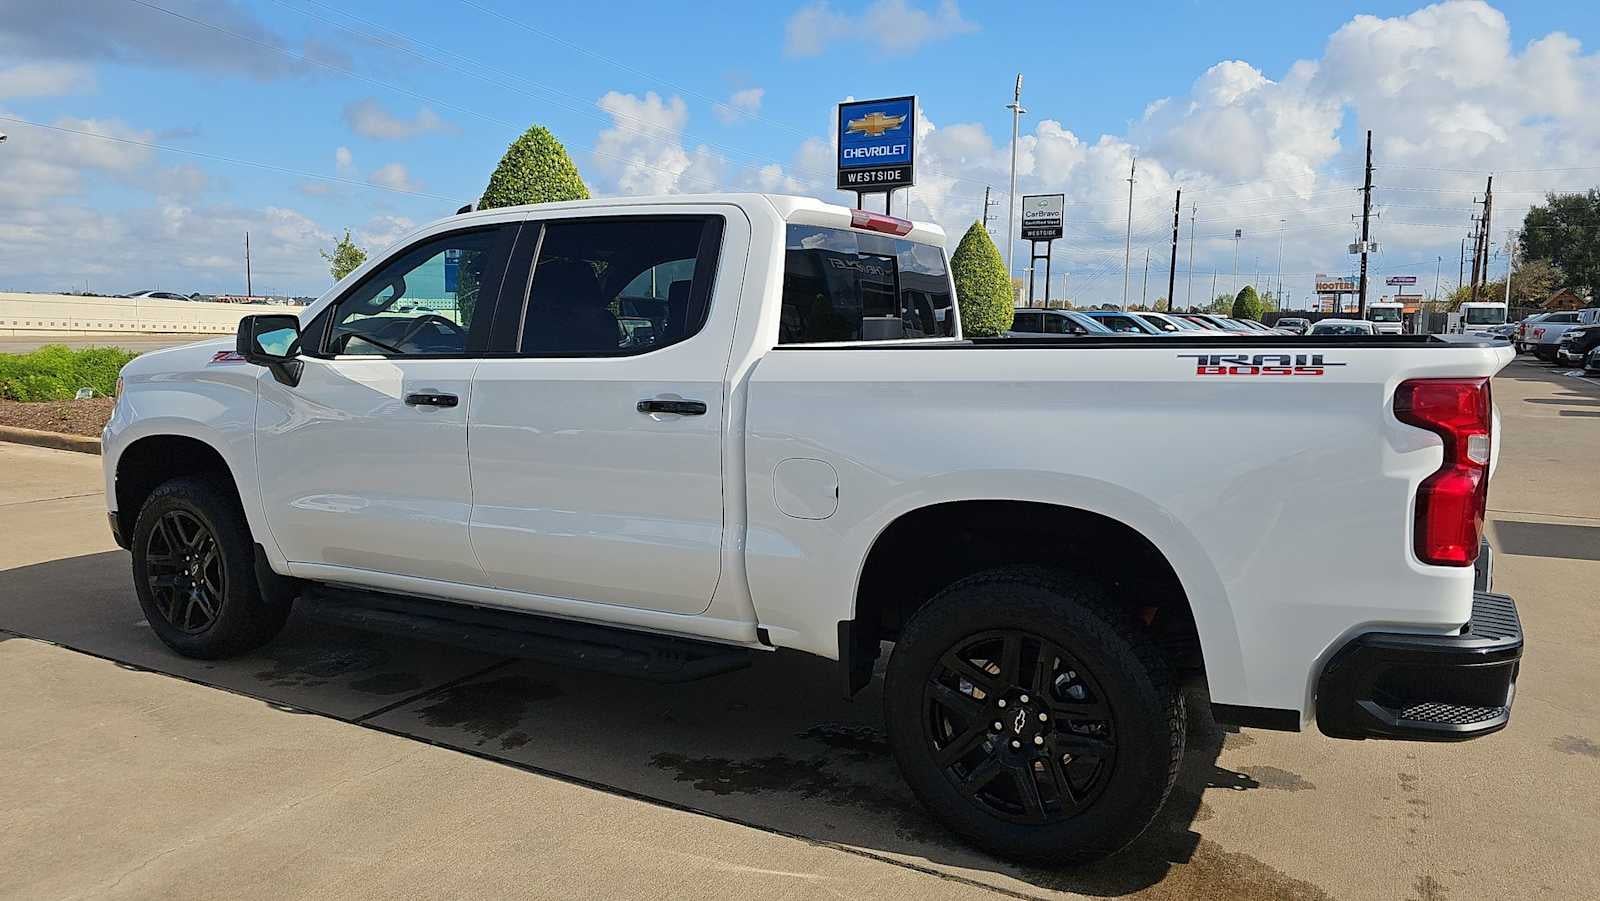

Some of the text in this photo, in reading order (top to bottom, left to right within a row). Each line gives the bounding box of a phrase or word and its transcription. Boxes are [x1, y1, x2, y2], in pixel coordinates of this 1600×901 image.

[843, 144, 907, 159] CHEVROLET
[847, 170, 902, 182] WESTSIDE
[1316, 282, 1355, 290] HOOTERS
[1176, 354, 1347, 366] TRAIL
[1196, 366, 1324, 376] BOSS
